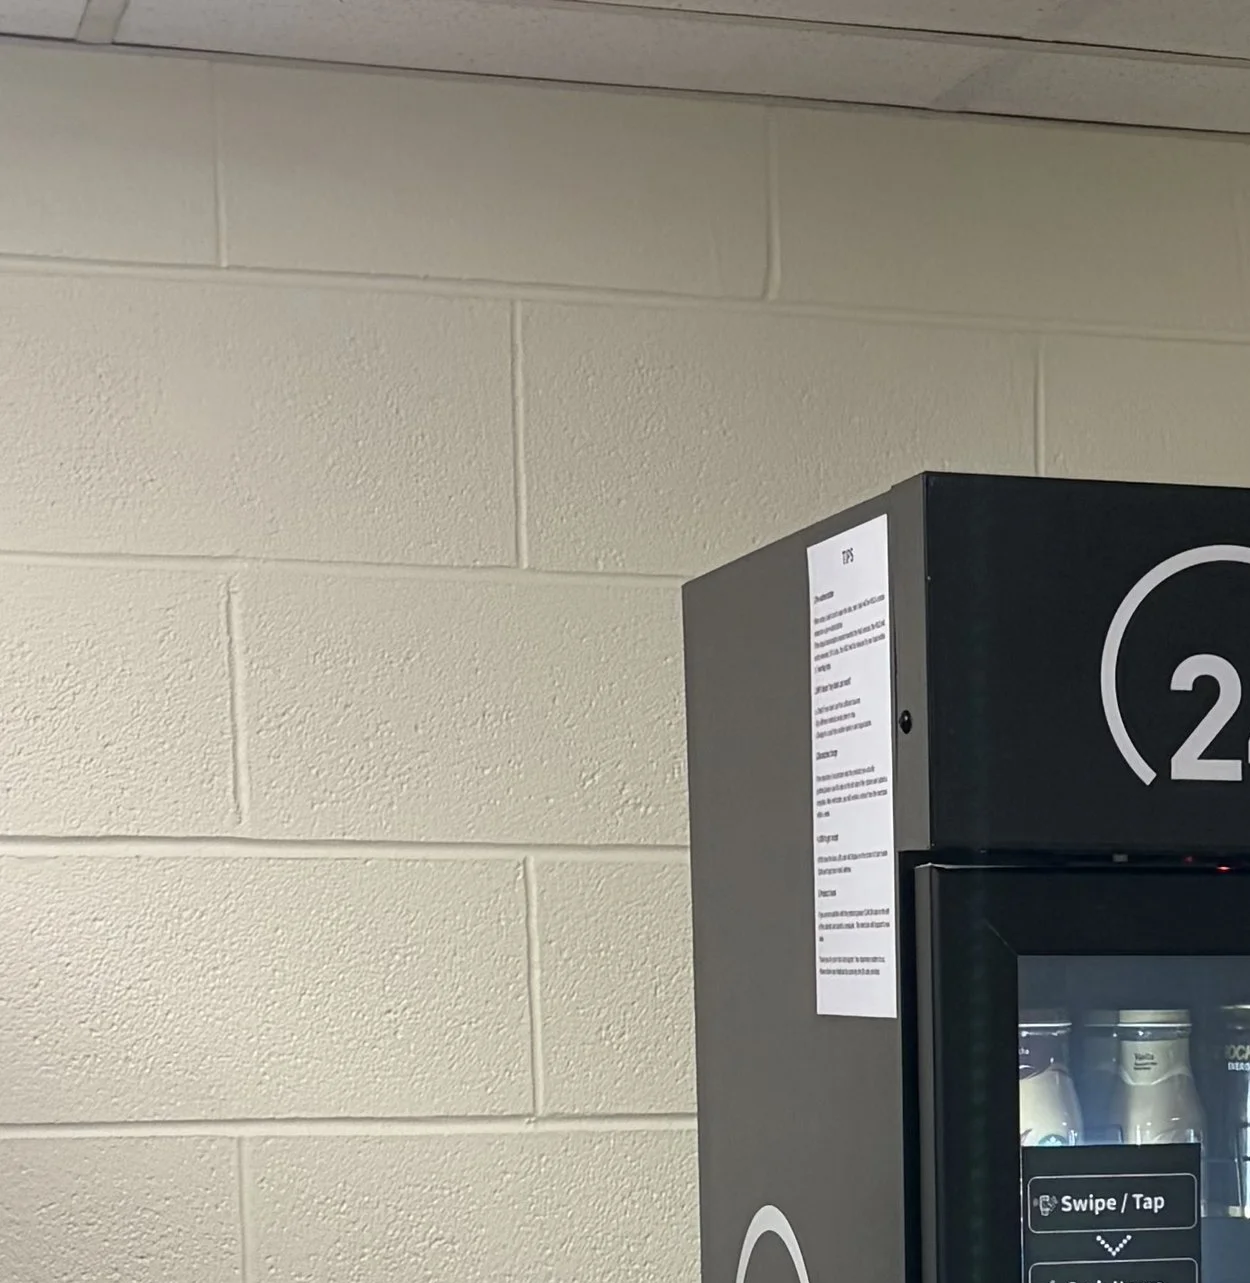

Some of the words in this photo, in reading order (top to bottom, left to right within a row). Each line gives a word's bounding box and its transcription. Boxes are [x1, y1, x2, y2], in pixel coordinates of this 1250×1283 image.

[1061, 1194, 1117, 1215] Swipe
[1120, 1193, 1128, 1214] /
[1132, 1194, 1165, 1214] Tap
